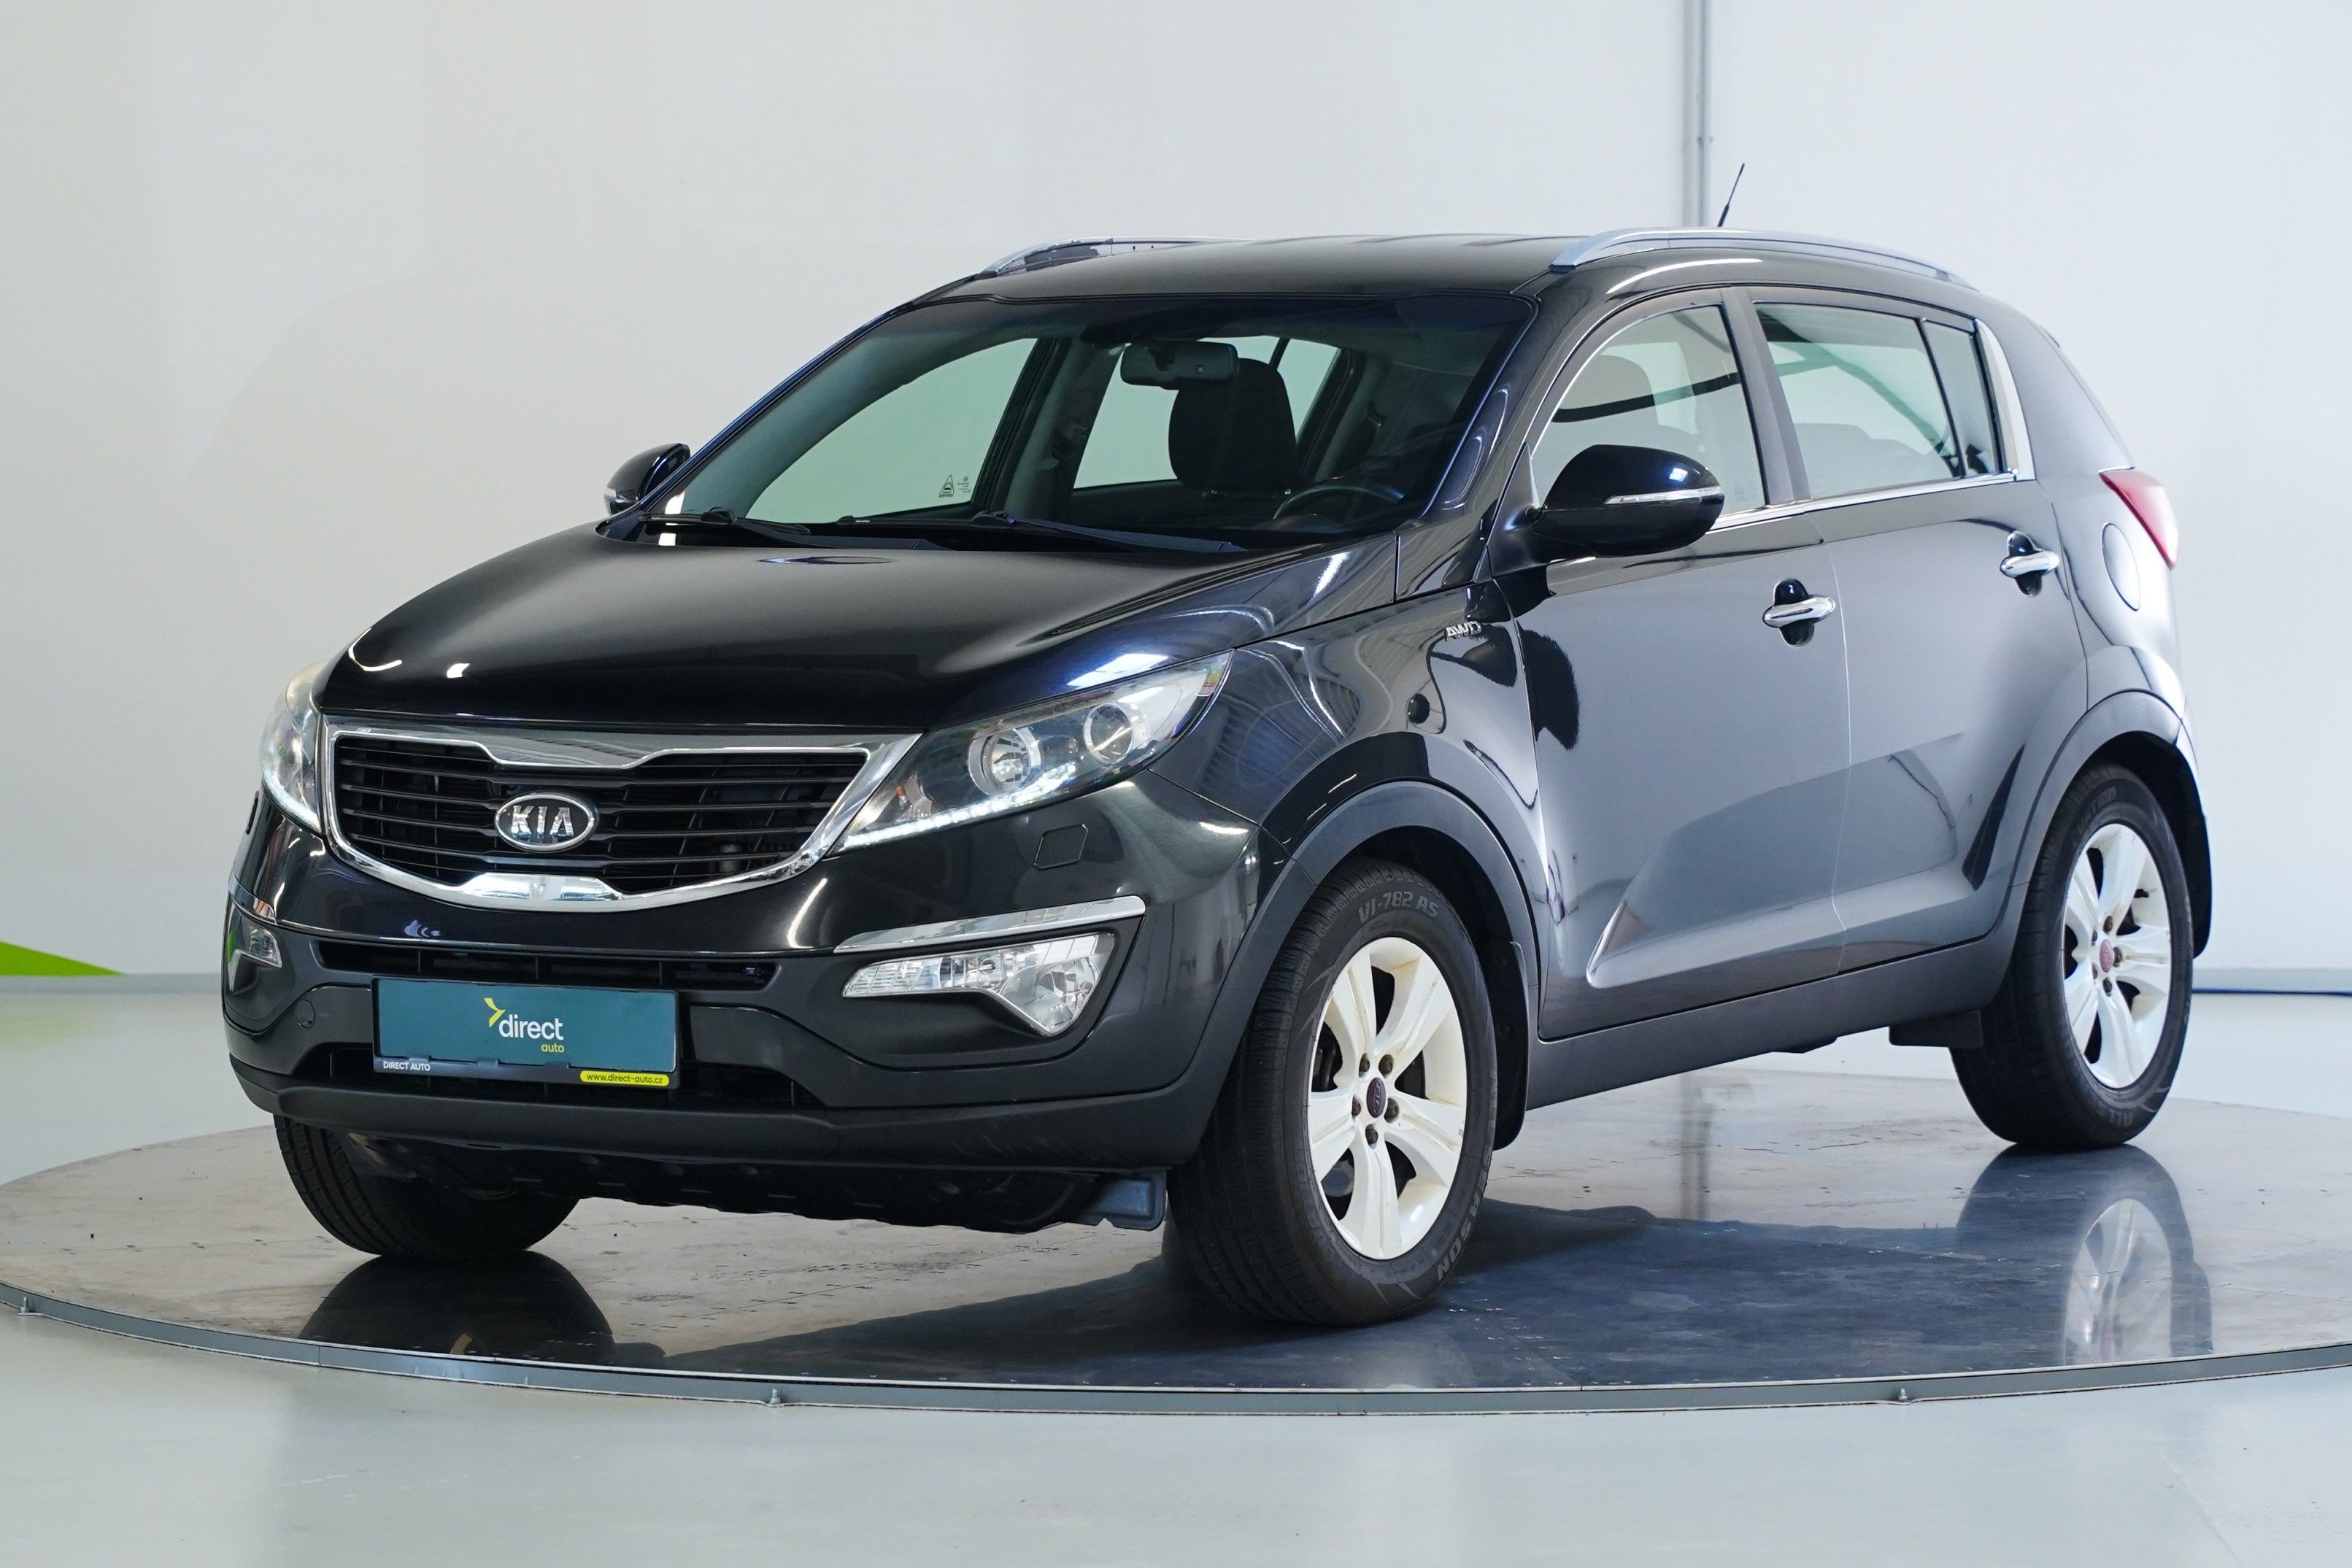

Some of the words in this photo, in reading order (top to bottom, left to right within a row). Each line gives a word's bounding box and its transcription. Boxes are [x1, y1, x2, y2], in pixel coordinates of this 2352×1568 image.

[1446, 621, 1481, 638] AWD
[511, 805, 575, 837] KIA
[1358, 890, 1414, 924] VI-782
[1415, 895, 1441, 918] AS
[498, 1013, 564, 1041] direct
[541, 1042, 565, 1053] auto
[382, 1060, 409, 1070] DIRECT
[410, 1062, 431, 1072] AUTO
[586, 1073, 663, 1084] www.direct-auto.cz
